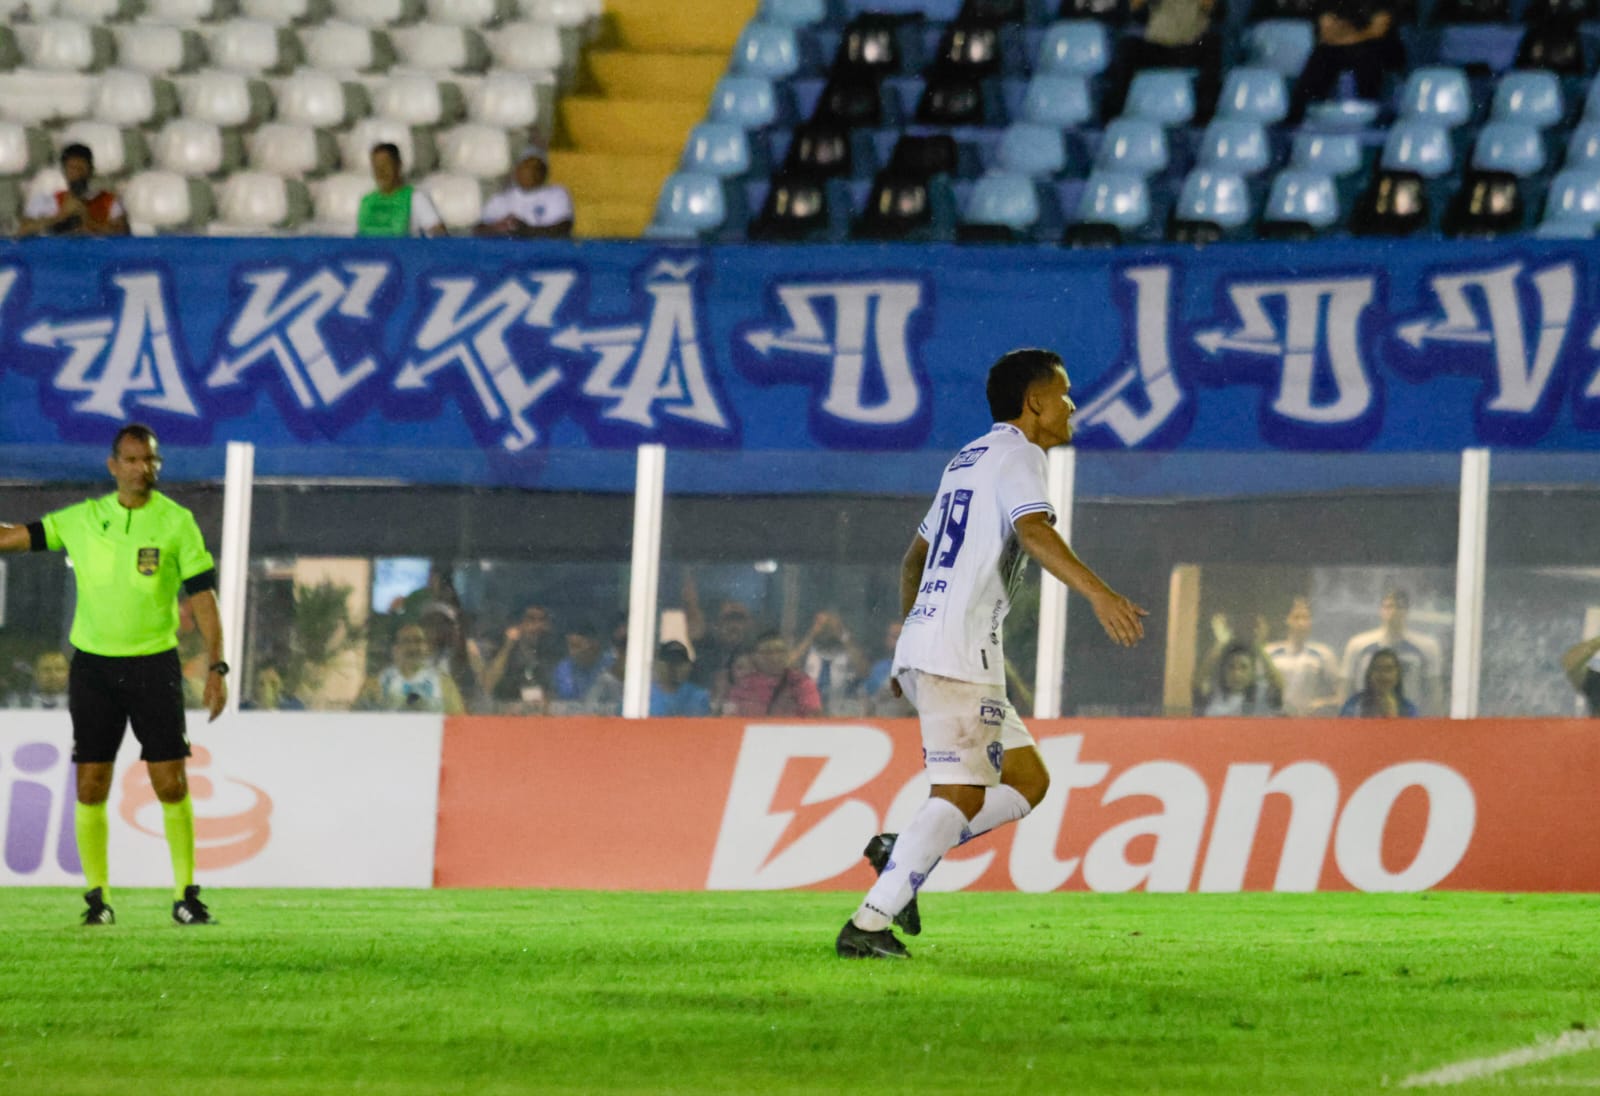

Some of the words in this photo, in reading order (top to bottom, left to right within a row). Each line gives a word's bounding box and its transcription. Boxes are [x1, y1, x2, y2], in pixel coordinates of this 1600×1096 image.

[1075, 261, 1600, 446] JOV
[927, 489, 974, 569] 19
[705, 723, 1478, 893] Betano
